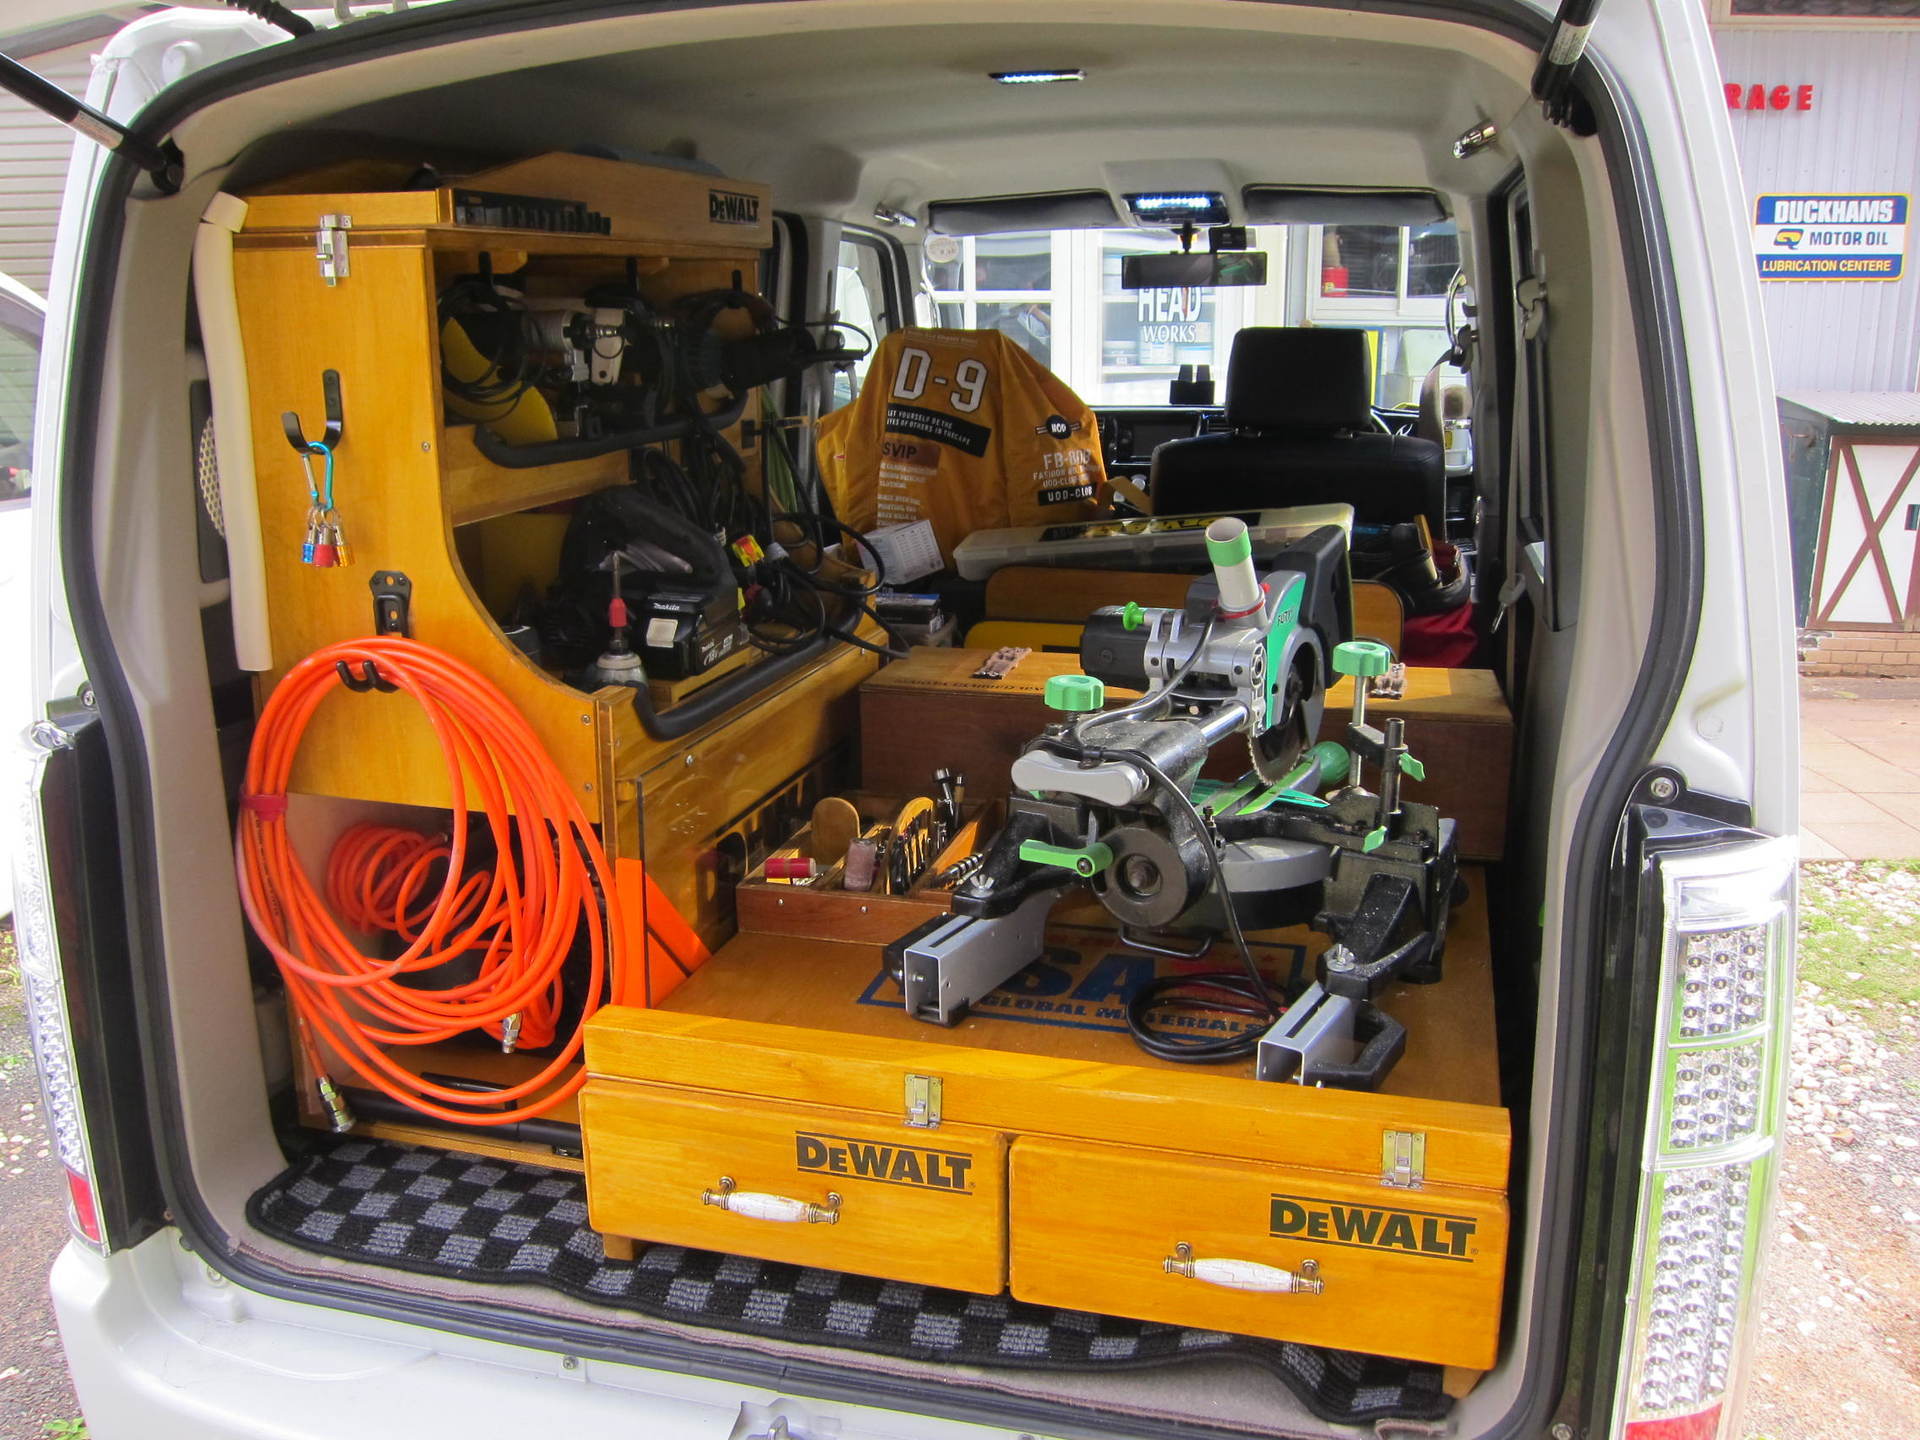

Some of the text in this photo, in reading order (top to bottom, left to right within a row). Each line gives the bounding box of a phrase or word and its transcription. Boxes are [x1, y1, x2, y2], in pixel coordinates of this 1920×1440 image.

[1774, 200, 1893, 224] DUCKHAMS
[1809, 231, 1862, 245] MOTOR
[1865, 231, 1888, 245] OIL
[1762, 260, 1892, 271] LUBRICATION CENTERE
[1138, 287, 1201, 322] HEAD
[1142, 324, 1196, 343] WORKS
[893, 347, 988, 413] D-9
[882, 441, 917, 459] SVIP
[796, 1135, 972, 1190] DEWALT
[1270, 1199, 1476, 1257] DEWALT
